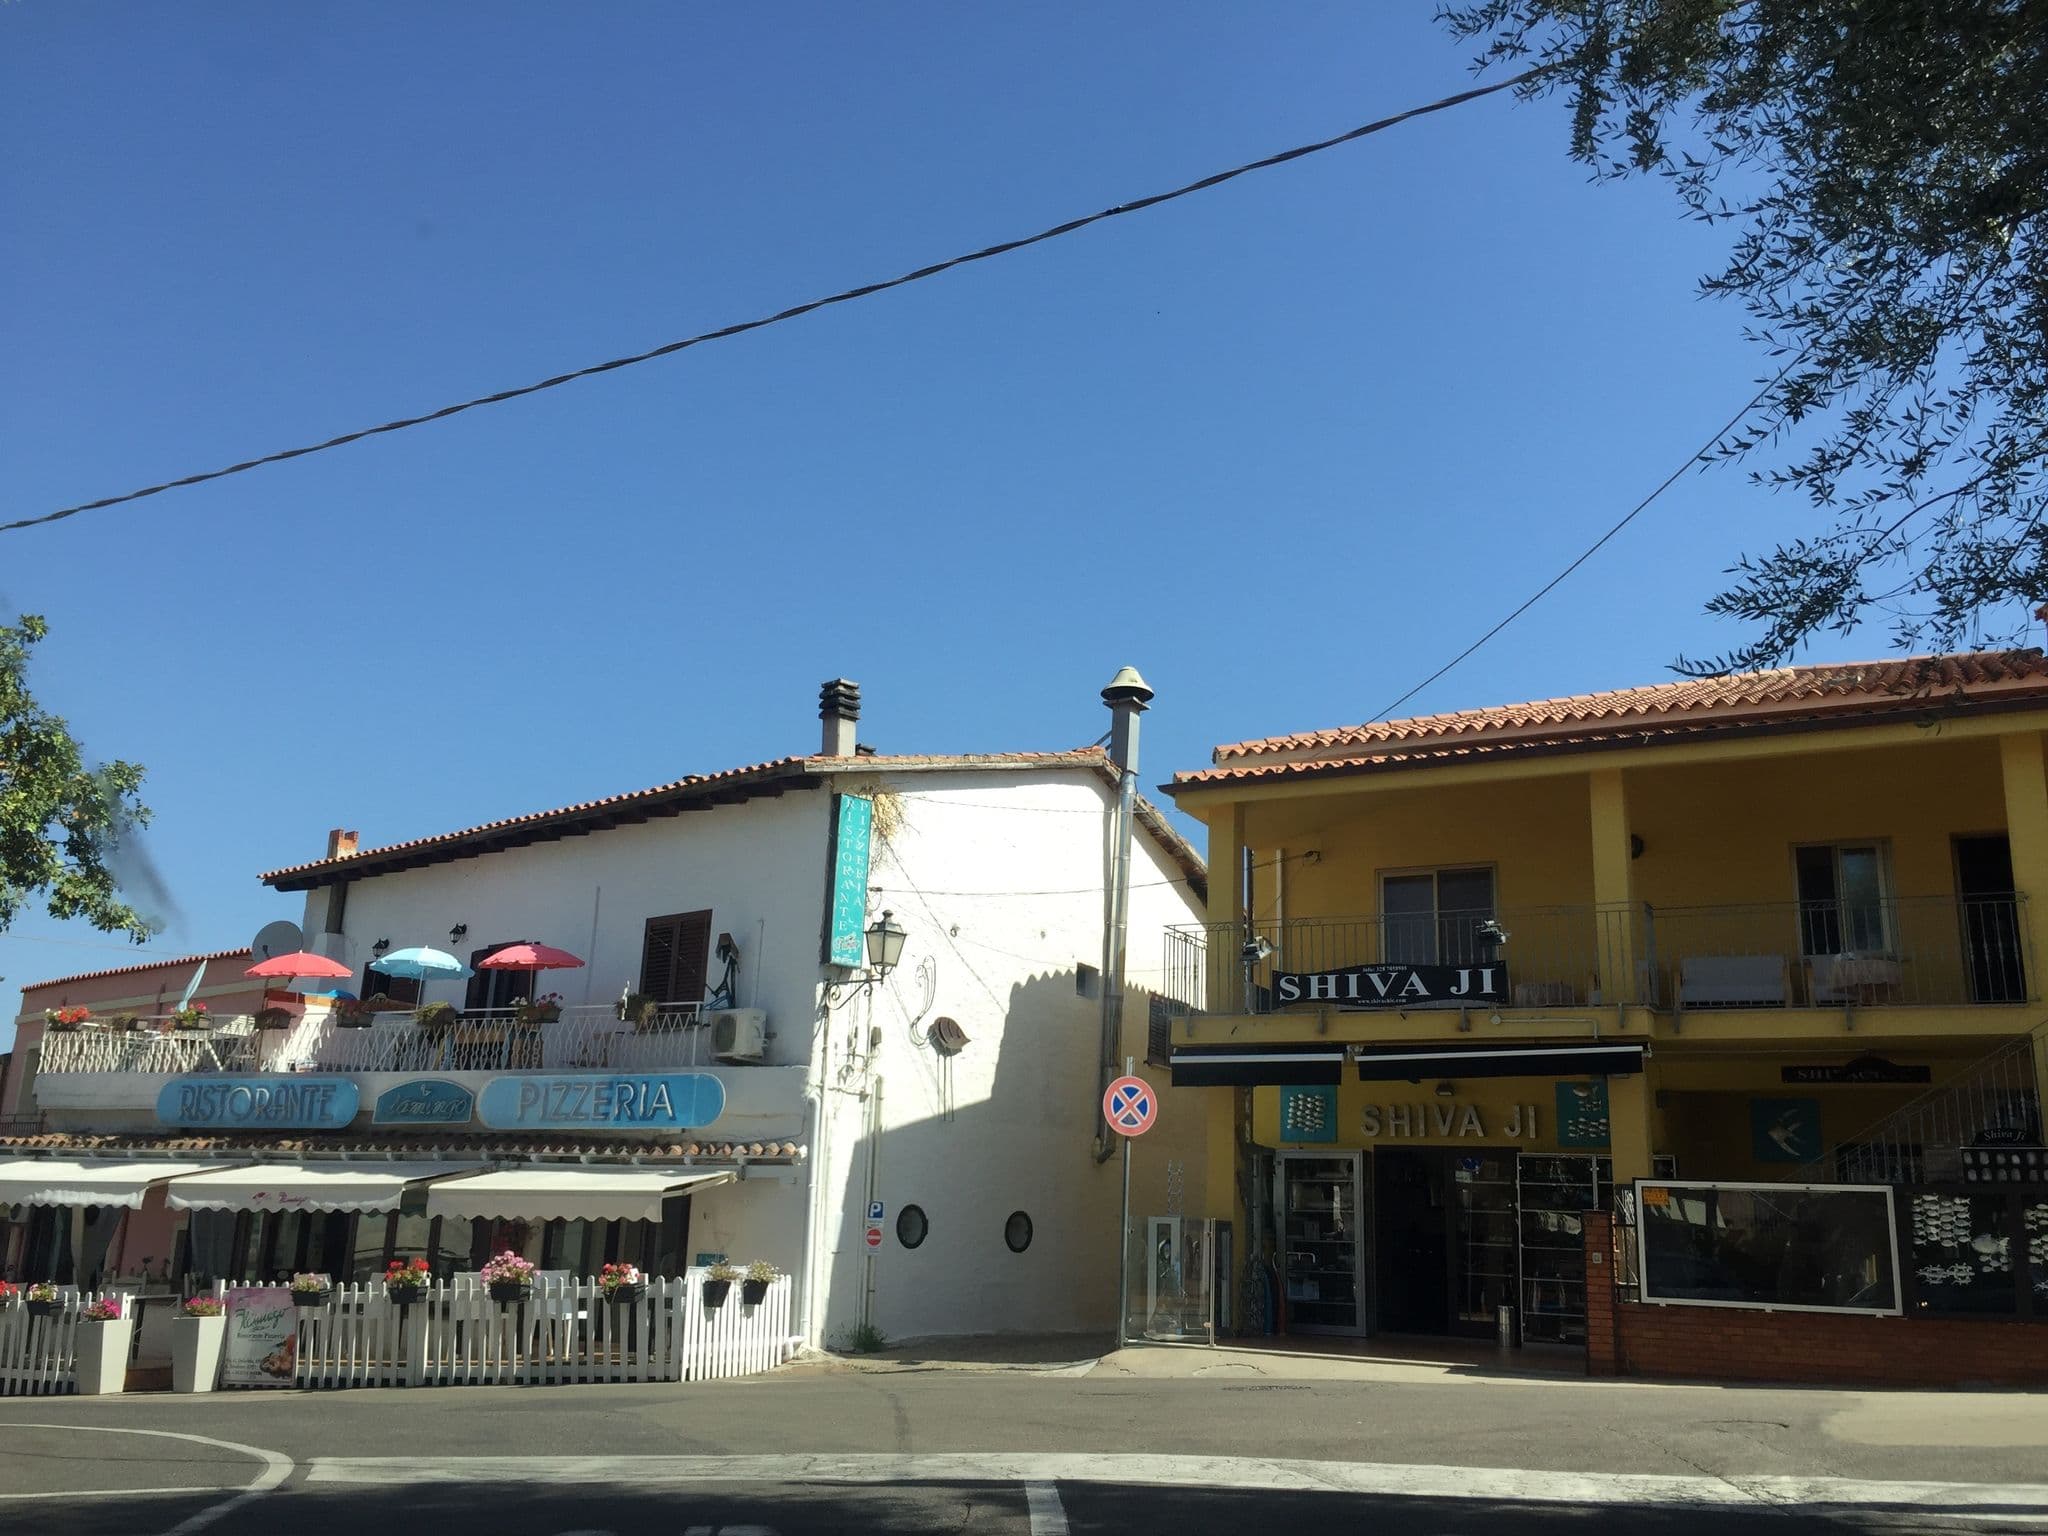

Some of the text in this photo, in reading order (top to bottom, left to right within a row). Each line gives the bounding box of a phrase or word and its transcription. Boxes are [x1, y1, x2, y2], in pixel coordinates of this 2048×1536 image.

[838, 799, 855, 932] RISTORANTE
[853, 801, 869, 907] PIZZERIA
[1279, 968, 1497, 1001] SHIVA JI
[179, 1083, 337, 1122] RISTORANTE
[391, 1094, 468, 1119] lamingo
[516, 1080, 677, 1122] PIZZERIA
[1361, 1103, 1537, 1139] SHIVA JI
[869, 1202, 882, 1217] P
